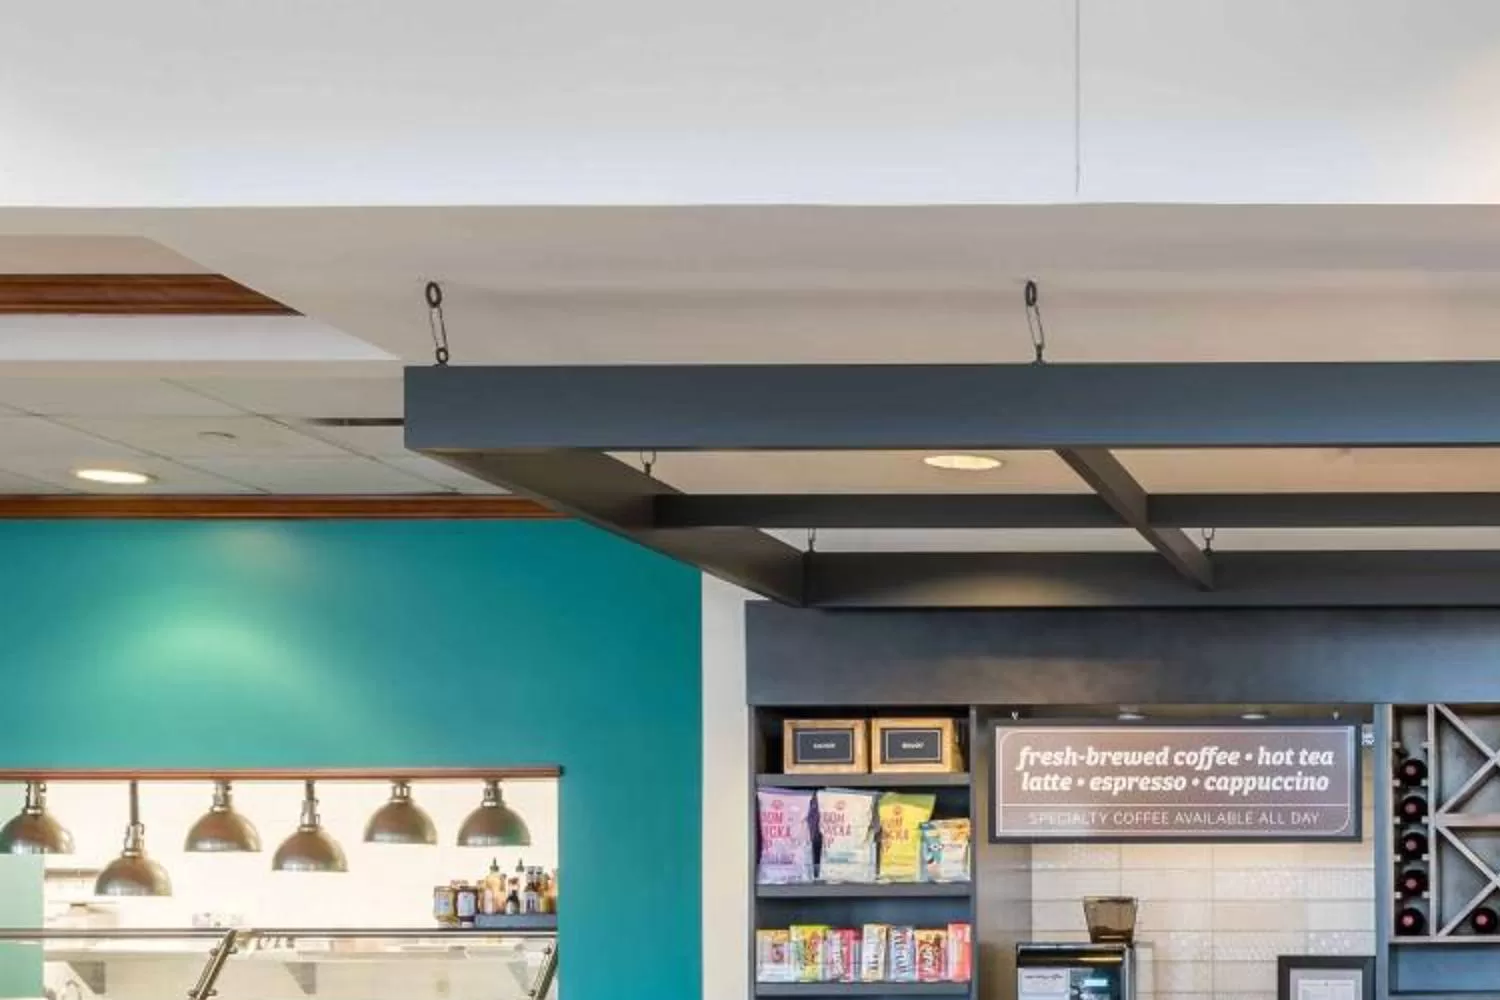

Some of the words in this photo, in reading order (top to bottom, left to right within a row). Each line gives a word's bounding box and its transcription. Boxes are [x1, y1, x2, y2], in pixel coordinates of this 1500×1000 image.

[1016, 746, 1169, 771] fresh-brewed
[1173, 747, 1240, 771] coffee
[1257, 747, 1294, 766] hot
[1298, 748, 1334, 766] tea
[1021, 773, 1072, 792] latte
[1089, 776, 1187, 796] espresso
[1204, 772, 1330, 796] cappuccino
[1028, 811, 1109, 825] SPECIALTY
[1112, 811, 1169, 825] COFFEE
[1174, 811, 1254, 825] AVAILABLE
[1258, 811, 1286, 825] ALL
[1291, 811, 1320, 825] DAY
